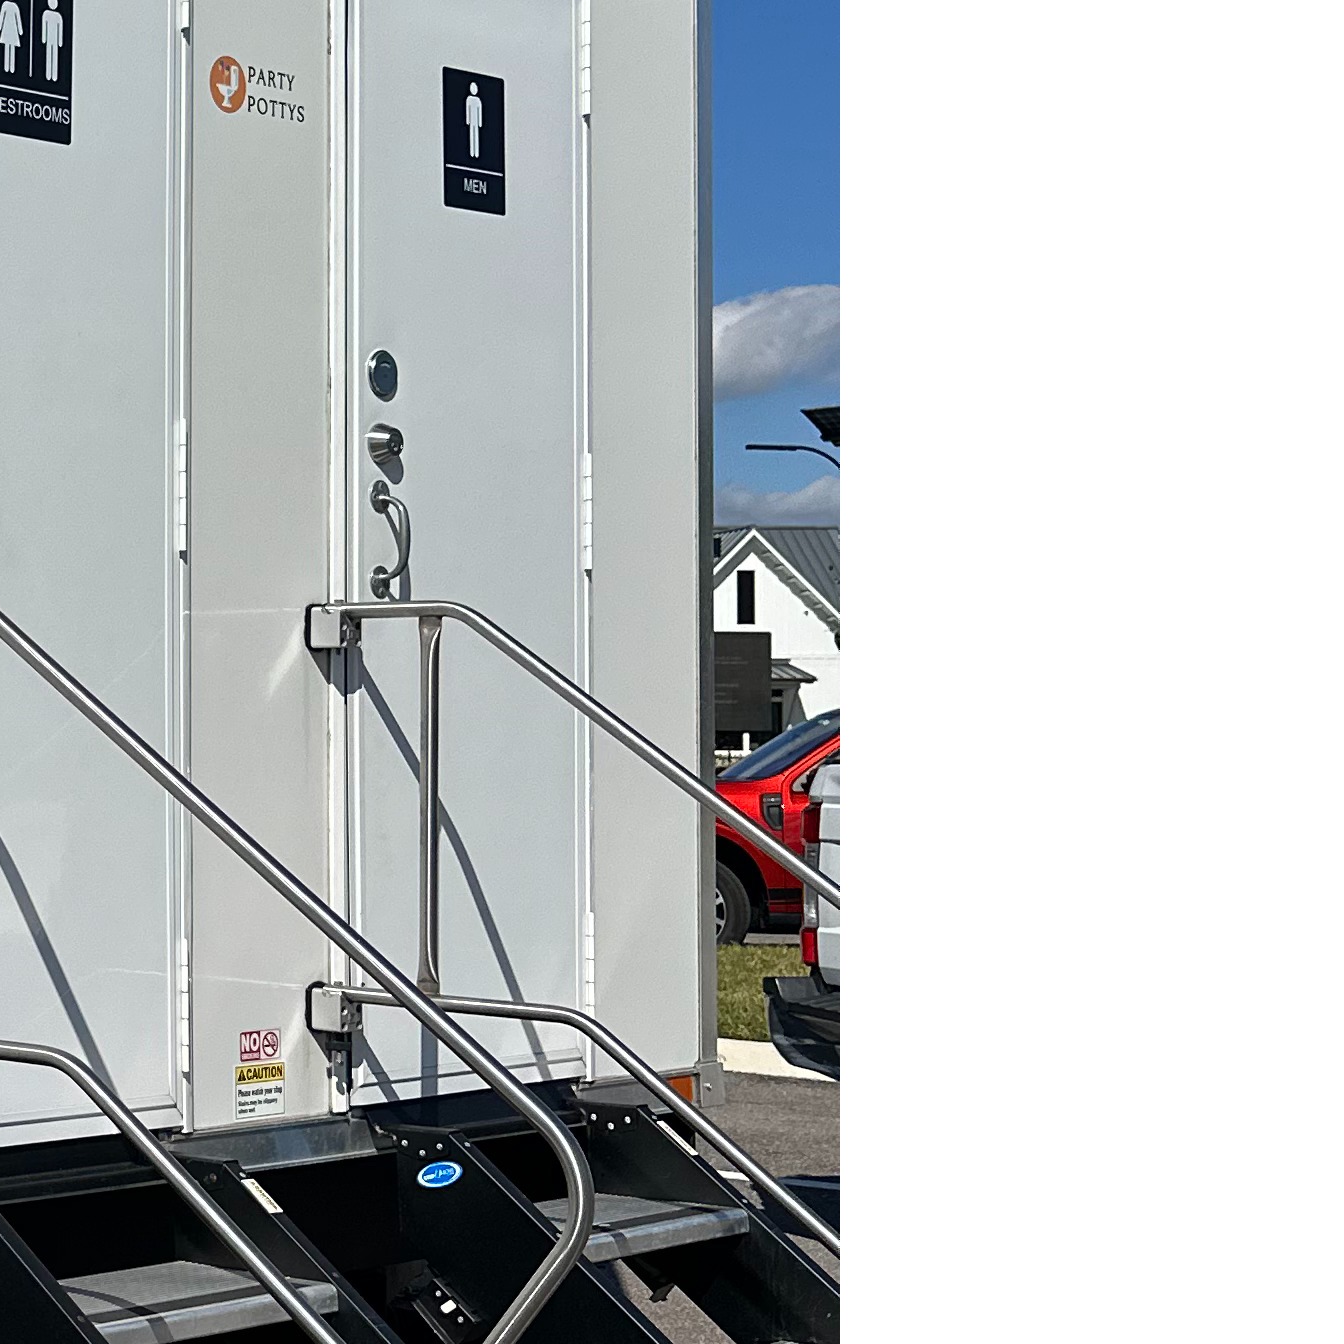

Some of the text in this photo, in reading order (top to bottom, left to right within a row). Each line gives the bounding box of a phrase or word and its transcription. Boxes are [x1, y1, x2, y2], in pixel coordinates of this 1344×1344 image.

[247, 65, 296, 92] PARTY
[247, 95, 305, 123] POTTYS
[463, 177, 487, 195] MEN
[241, 1032, 259, 1053] NO
[246, 1065, 282, 1080] CAUTION
